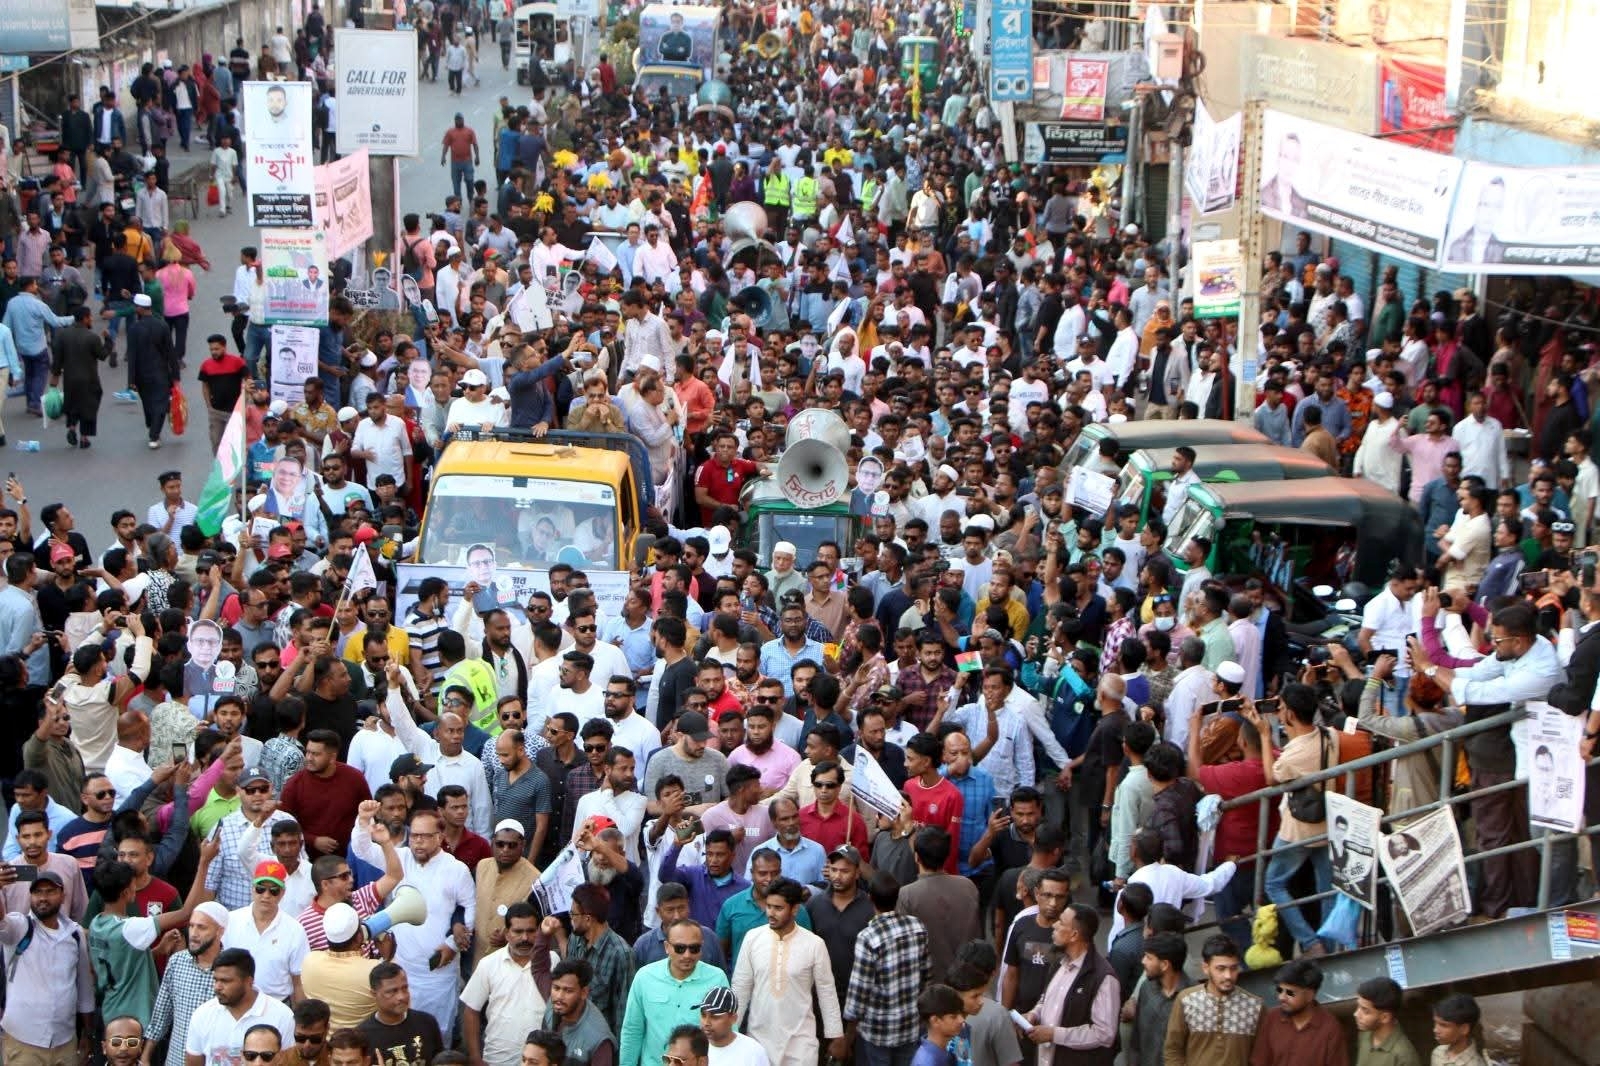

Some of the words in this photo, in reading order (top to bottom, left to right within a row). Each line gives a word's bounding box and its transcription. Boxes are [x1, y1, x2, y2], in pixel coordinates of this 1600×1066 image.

[346, 69, 377, 85] CALL
[381, 70, 407, 85] FOR
[347, 86, 406, 97] ADVERTISEMENT
